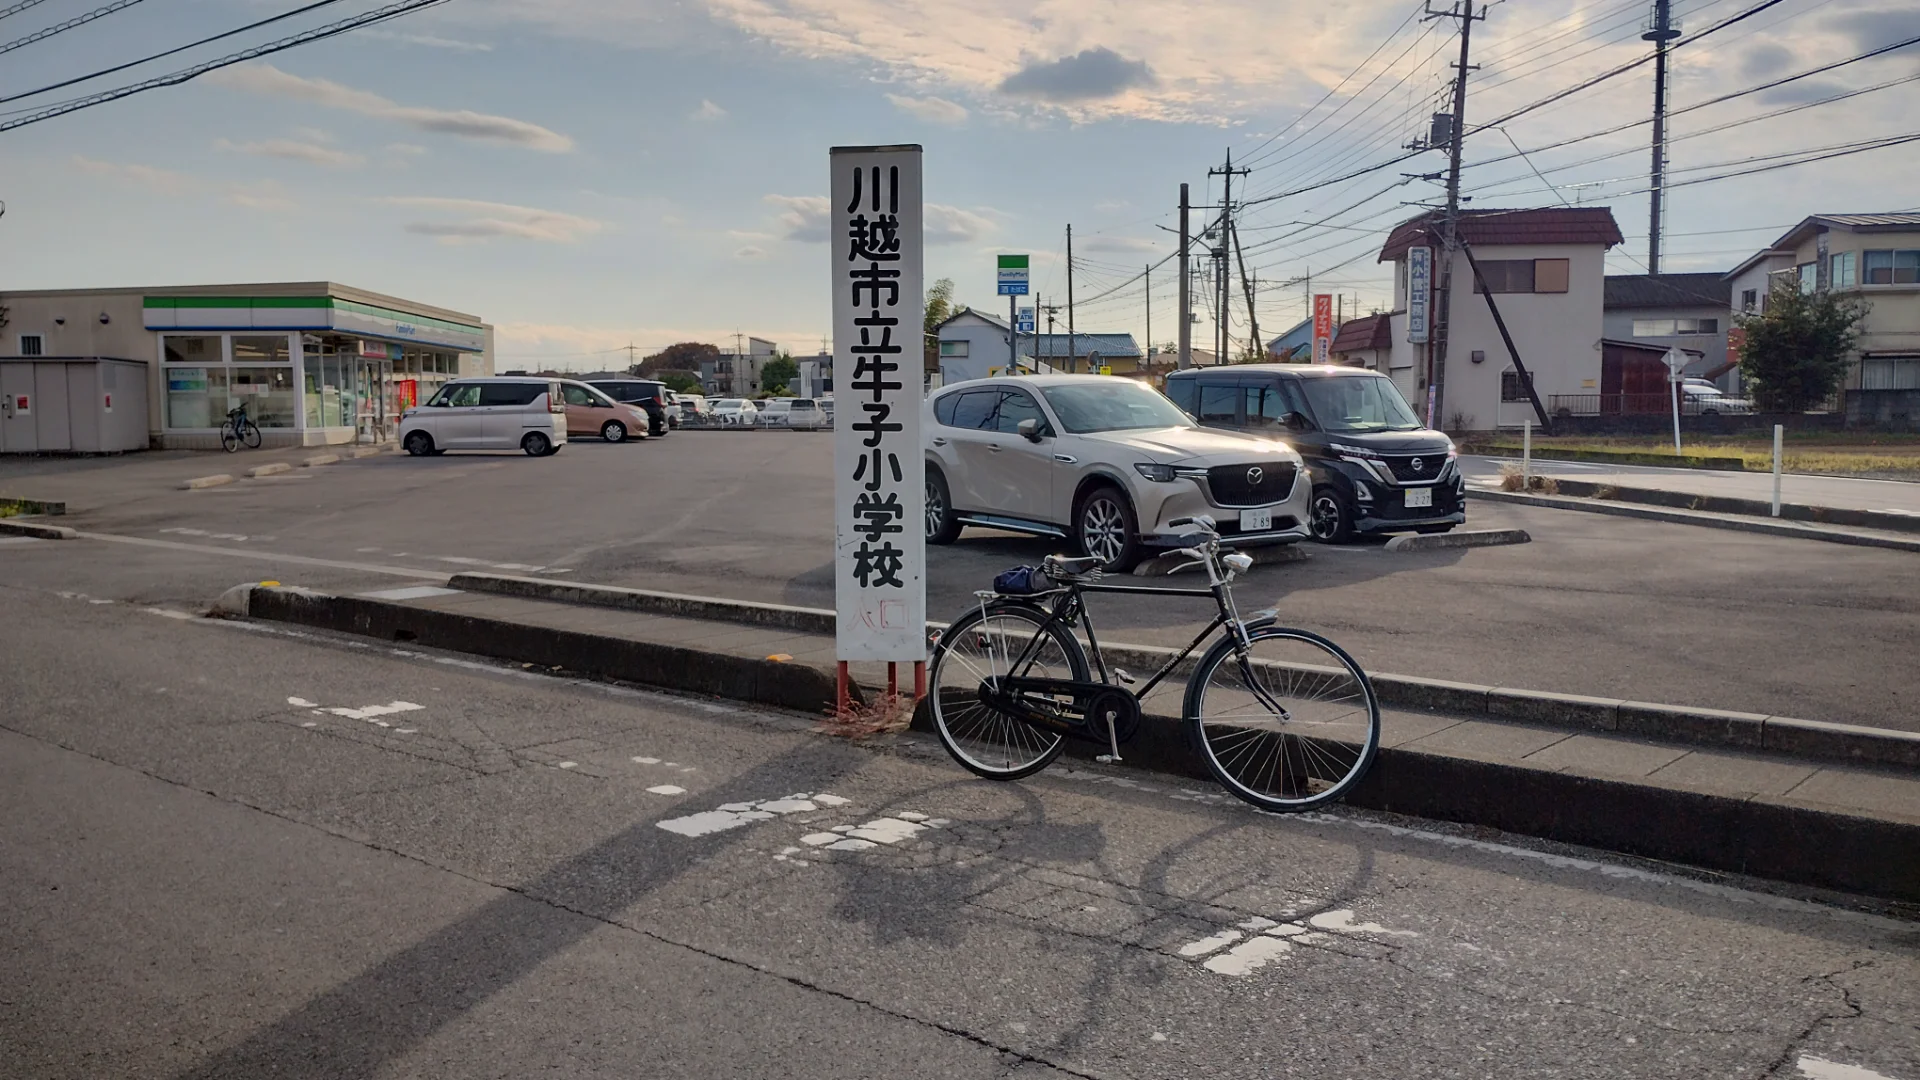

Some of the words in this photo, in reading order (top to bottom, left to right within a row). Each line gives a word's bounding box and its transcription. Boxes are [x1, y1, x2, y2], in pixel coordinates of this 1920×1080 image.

[846, 165, 905, 589] 川越市立牛子小学校
[999, 271, 1028, 279] FamilyMart
